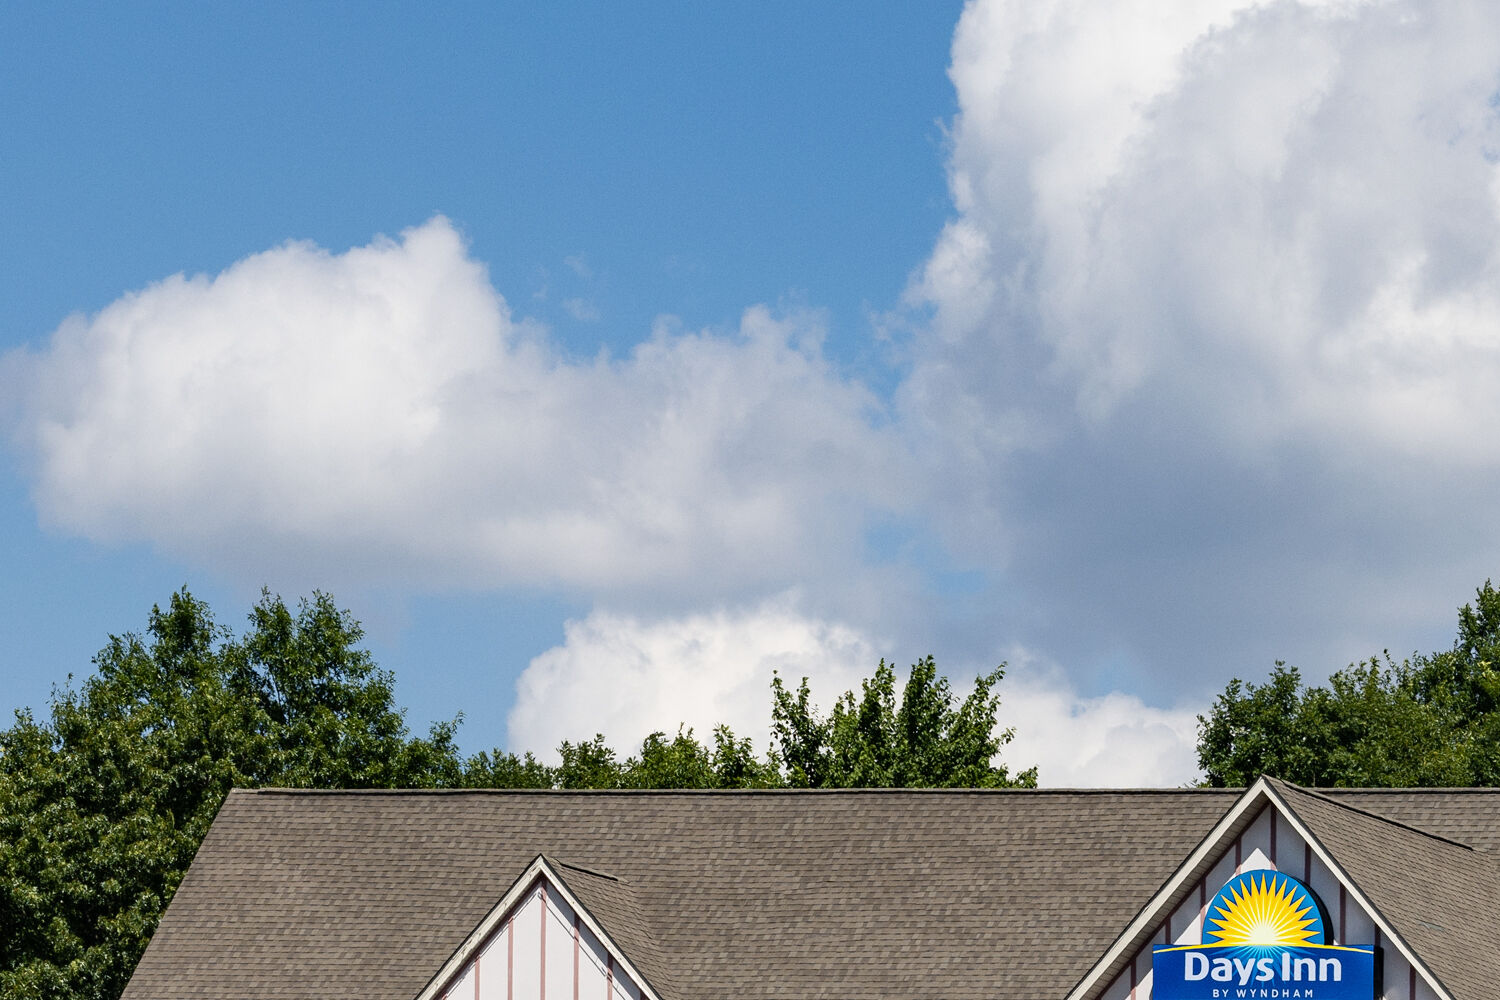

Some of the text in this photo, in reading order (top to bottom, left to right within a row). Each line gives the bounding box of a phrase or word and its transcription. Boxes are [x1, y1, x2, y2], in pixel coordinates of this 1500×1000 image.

[1184, 951, 1342, 986] Days Inn
[1212, 989, 1314, 998] BY WYNDHAM
